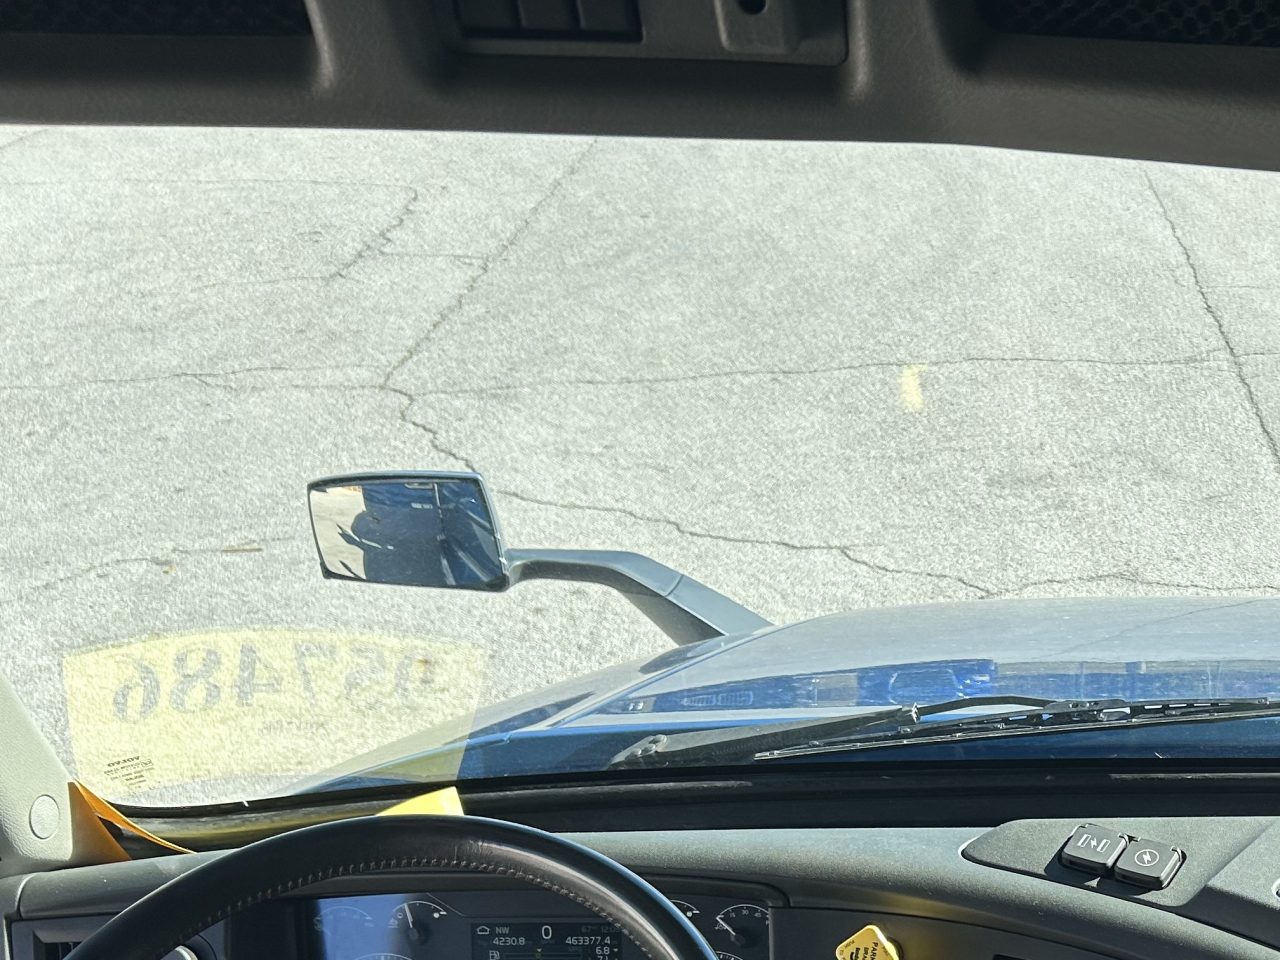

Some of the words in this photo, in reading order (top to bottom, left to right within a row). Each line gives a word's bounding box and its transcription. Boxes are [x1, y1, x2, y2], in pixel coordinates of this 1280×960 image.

[495, 926, 510, 934] NW
[492, 936, 526, 946] 4230.8
[565, 936, 611, 946] 463377.4
[595, 946, 610, 955] 6.8
